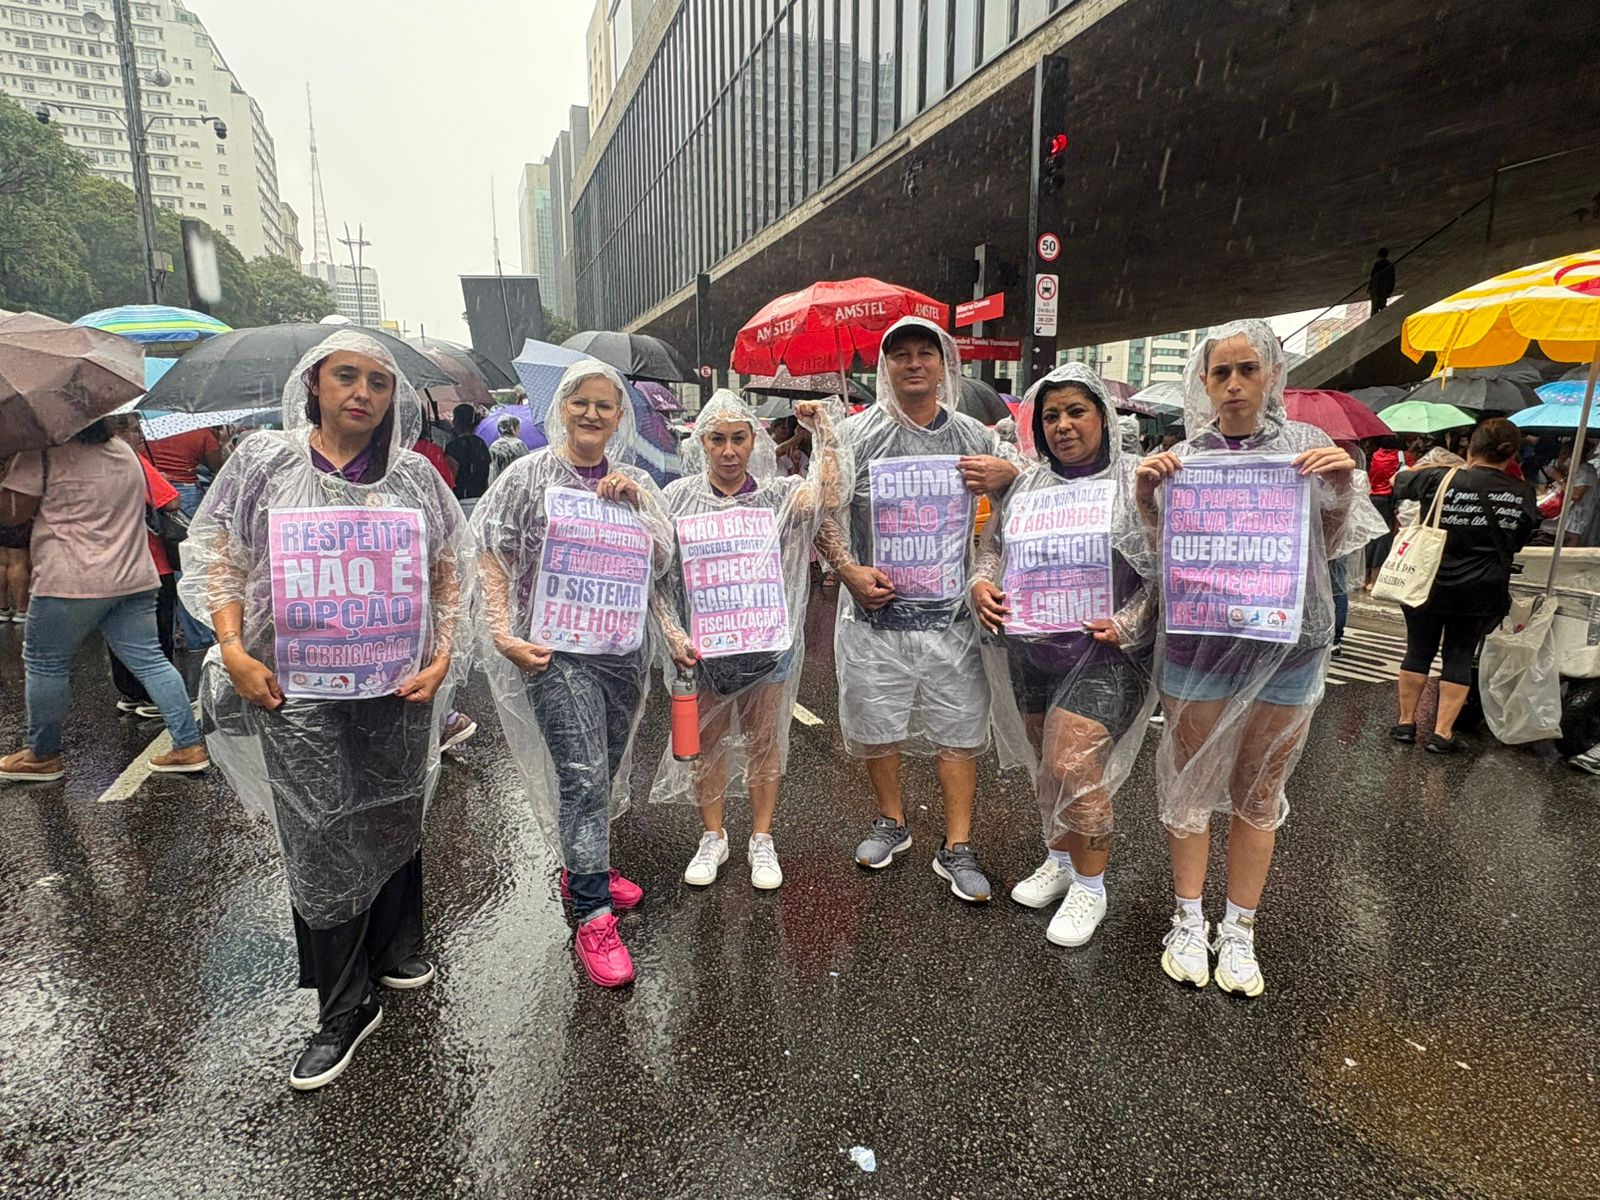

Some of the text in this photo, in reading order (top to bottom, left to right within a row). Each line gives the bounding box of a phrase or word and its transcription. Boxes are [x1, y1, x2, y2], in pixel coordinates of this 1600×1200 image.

[1042, 240, 1056, 252] 50
[835, 301, 887, 321] AMSTEL
[914, 303, 940, 320] AMSTEL
[877, 464, 964, 499] CIÚME
[1174, 468, 1296, 485] MEDIDA PROTETIVA
[554, 500, 575, 518] SE
[1172, 485, 1296, 509] NO PAPEL NÃO
[879, 496, 963, 534] NÃO É
[1009, 505, 1106, 535] O ABSURDO!
[1171, 511, 1294, 533] SALVA VIDAS!
[280, 519, 412, 553] RESPEITO
[556, 522, 646, 549] MEDIDA PROTETIVA
[684, 519, 719, 541] NÃO
[688, 541, 732, 557] CONCEDER
[880, 535, 937, 561] PROVA
[1010, 533, 1106, 570] VIOLÊNCIA
[1170, 535, 1293, 563] QUEREMOS
[284, 549, 414, 599] NÃO É
[568, 548, 645, 580] MORREU
[690, 557, 701, 586] É
[546, 574, 642, 608] O SISTEMA
[1169, 563, 1291, 604] PROTEÇÃO
[694, 583, 780, 614] GARANTIR
[1010, 587, 1105, 625] É CRIME
[285, 590, 413, 640] OPÇÃO
[543, 600, 640, 635] FALHOU!
[698, 608, 782, 635] FISCALIZAÇÃO!
[1171, 601, 1227, 628] REAL!
[287, 634, 411, 671] É OBRIGAÇÃO!
